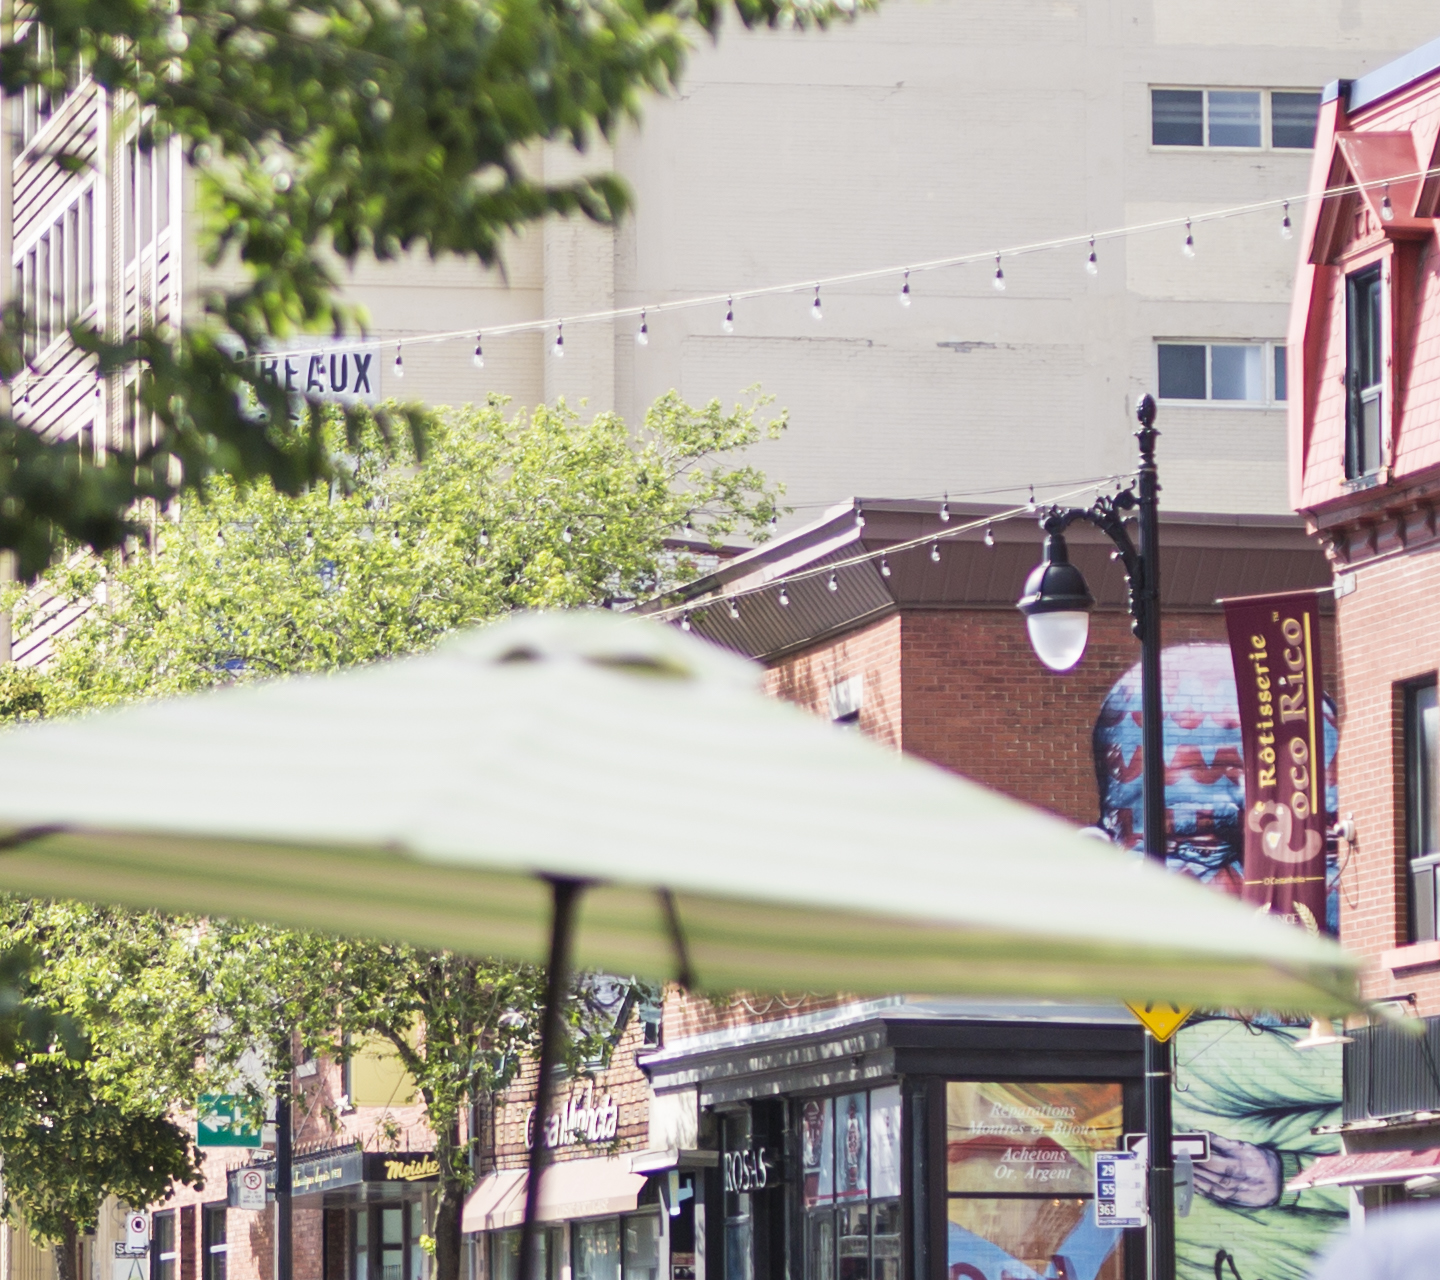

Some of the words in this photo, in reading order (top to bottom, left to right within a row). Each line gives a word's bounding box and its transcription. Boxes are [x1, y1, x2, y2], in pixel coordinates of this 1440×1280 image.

[1278, 618, 1309, 724] Rico
[1249, 634, 1277, 789] Rôtisserie
[990, 1102, 1077, 1119] Réparations
[967, 1121, 1025, 1135] Montres
[1031, 1122, 1045, 1135] et
[1001, 1146, 1067, 1162] Achetons
[384, 1153, 441, 1182] Moishe
[1023, 1165, 1072, 1182] Argent
[1101, 1164, 1115, 1177] 29
[1102, 1185, 1116, 1196] 55
[1099, 1204, 1116, 1216] 363
